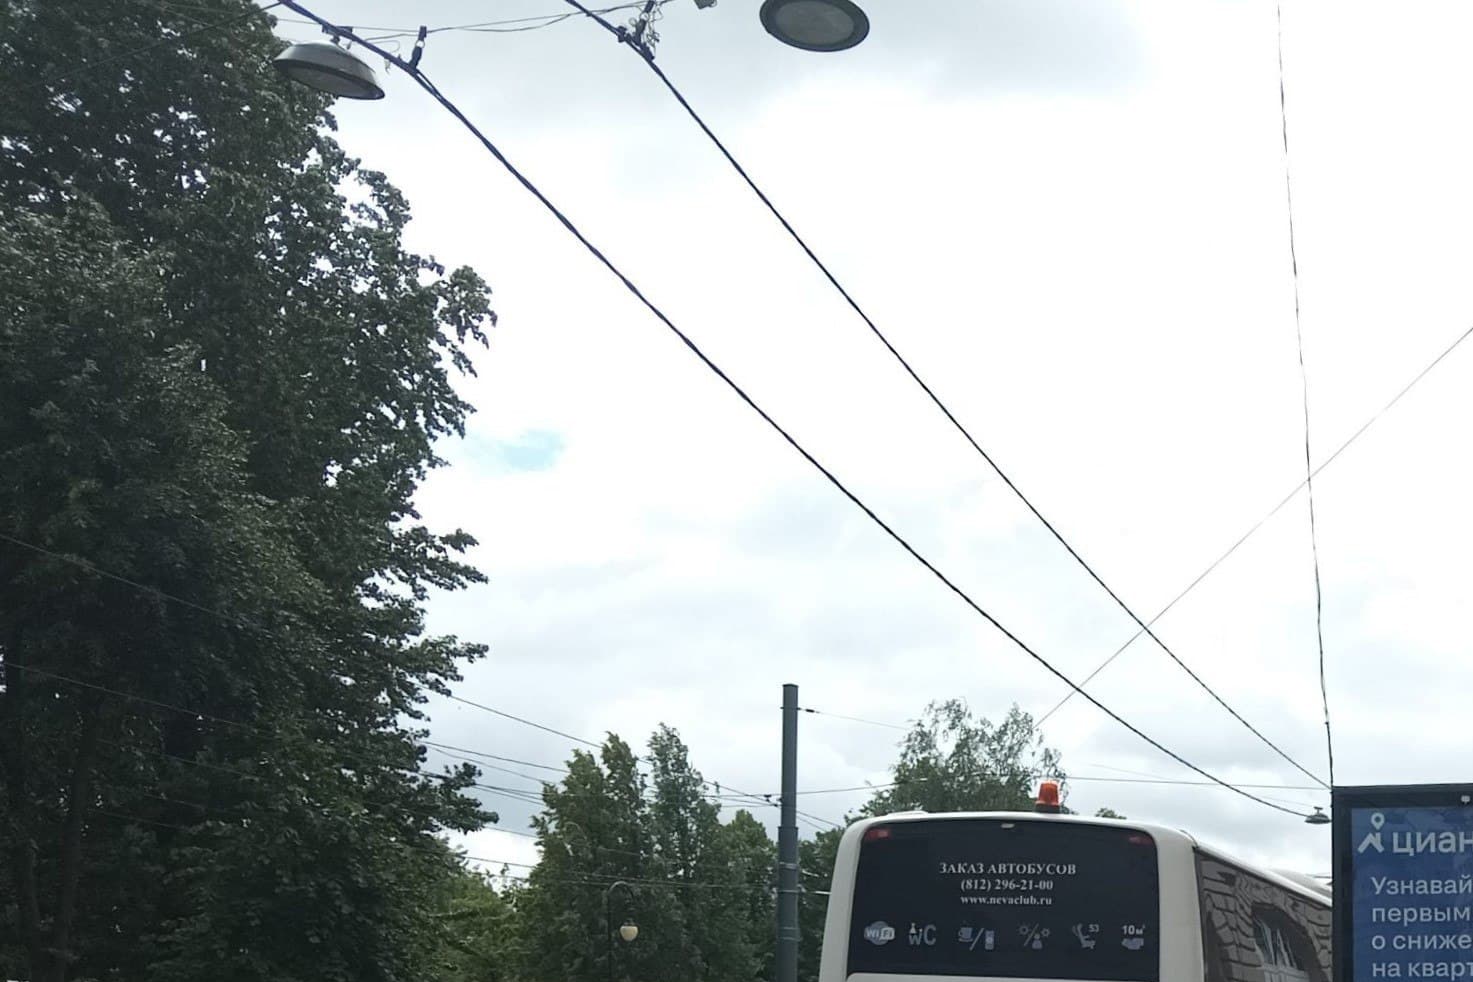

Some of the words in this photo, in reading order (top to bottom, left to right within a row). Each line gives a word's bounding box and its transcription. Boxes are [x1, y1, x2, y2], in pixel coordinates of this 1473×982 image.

[939, 863, 984, 874] ЗАКАЗ
[987, 863, 1076, 875] АВТОБУСОВ
[960, 879, 992, 891] (812)
[994, 879, 1054, 891] 296-21-00
[960, 895, 1052, 905] www.nevaclub.ru
[1088, 923, 1100, 933] 53
[1371, 936, 1386, 950] о
[1372, 961, 1401, 977] на
